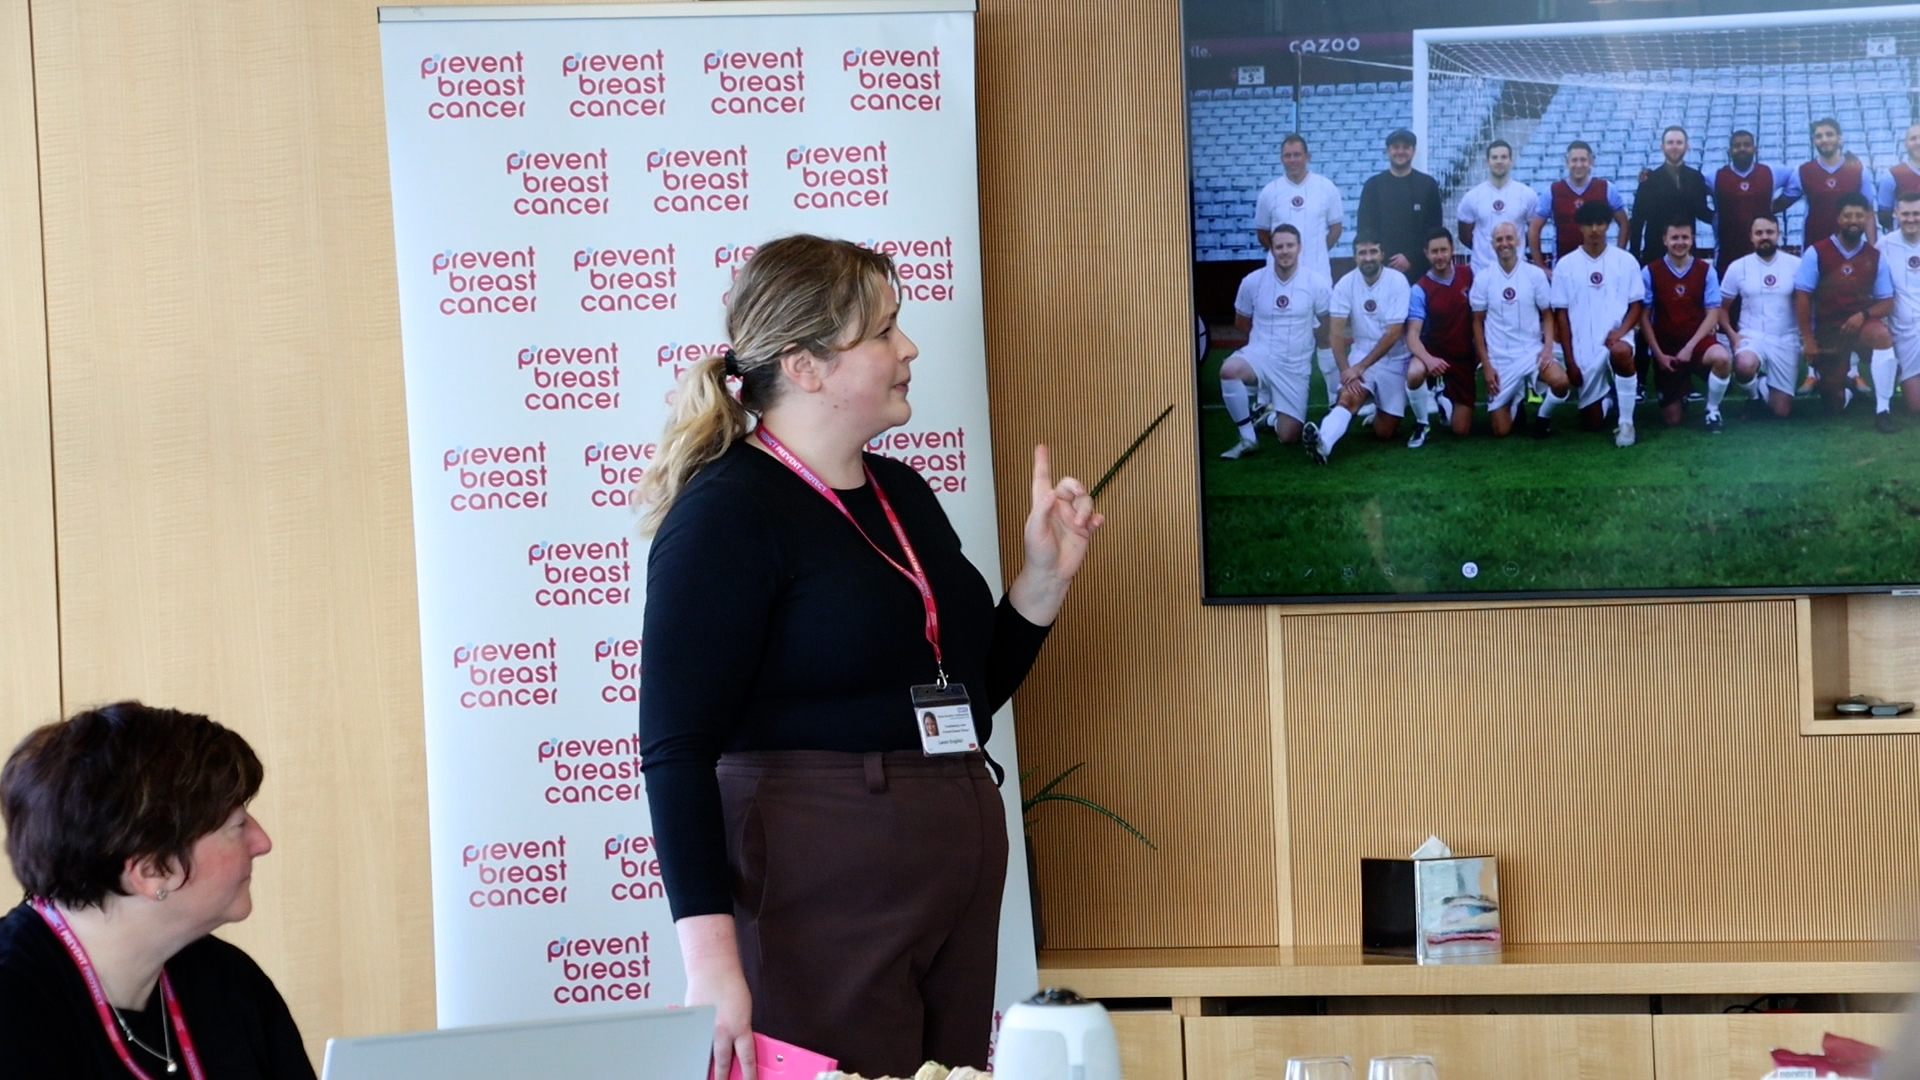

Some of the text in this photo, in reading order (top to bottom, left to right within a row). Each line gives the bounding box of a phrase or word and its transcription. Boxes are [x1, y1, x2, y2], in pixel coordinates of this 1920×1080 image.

[843, 45, 941, 70] prevent
[1288, 37, 1361, 55] CAZOO
[421, 50, 524, 78] prevent
[562, 48, 664, 75] prevent
[704, 46, 804, 72] prevent
[438, 75, 526, 97] breast
[579, 74, 667, 96] breast
[720, 72, 805, 93] breast
[859, 69, 941, 90] breast
[429, 100, 525, 119] cancer
[570, 98, 666, 118] cancer
[711, 96, 805, 115] cancer
[851, 93, 941, 111] cancer
[506, 147, 608, 174] prevent
[647, 144, 748, 172] prevent
[786, 139, 887, 168] prevent
[523, 171, 609, 194] breast
[662, 169, 749, 191] breast
[803, 164, 889, 188] breast
[514, 197, 609, 216] cancer
[654, 194, 748, 213] cancer
[794, 189, 889, 210] cancer
[574, 243, 676, 271] prevent
[859, 236, 952, 257] revent
[433, 245, 536, 274] prevent
[898, 259, 953, 280] east
[449, 270, 538, 293] breast
[590, 267, 677, 290] breast
[581, 293, 676, 312] cancer
[901, 284, 954, 302] ncer
[440, 295, 537, 316] cancer
[518, 342, 619, 368] prevent
[534, 366, 620, 389] breast
[525, 392, 620, 411] cancer
[444, 440, 547, 470] prevent
[585, 442, 657, 467] preve
[460, 466, 548, 489] breast
[600, 463, 645, 486] bre
[775, 446, 802, 470] PREVENT
[800, 468, 828, 492] PROTECT
[926, 475, 967, 493] cer
[451, 491, 547, 511] cancer
[528, 536, 629, 564] prevent
[544, 561, 631, 584] breast
[536, 587, 630, 607] cancer
[454, 636, 557, 667] prevent
[470, 662, 558, 686] breast
[460, 688, 558, 709] cancer
[538, 732, 641, 762] prevent
[554, 756, 642, 782] breast
[545, 783, 640, 804] cancer
[463, 835, 567, 865] prevent
[480, 859, 567, 885] breast
[619, 856, 663, 879] bre
[470, 886, 567, 908] cancer
[610, 880, 664, 902] can
[60, 930, 88, 966] PREVENT
[547, 930, 650, 962] prevent
[563, 956, 651, 982] breast
[554, 982, 651, 1004] cancer
